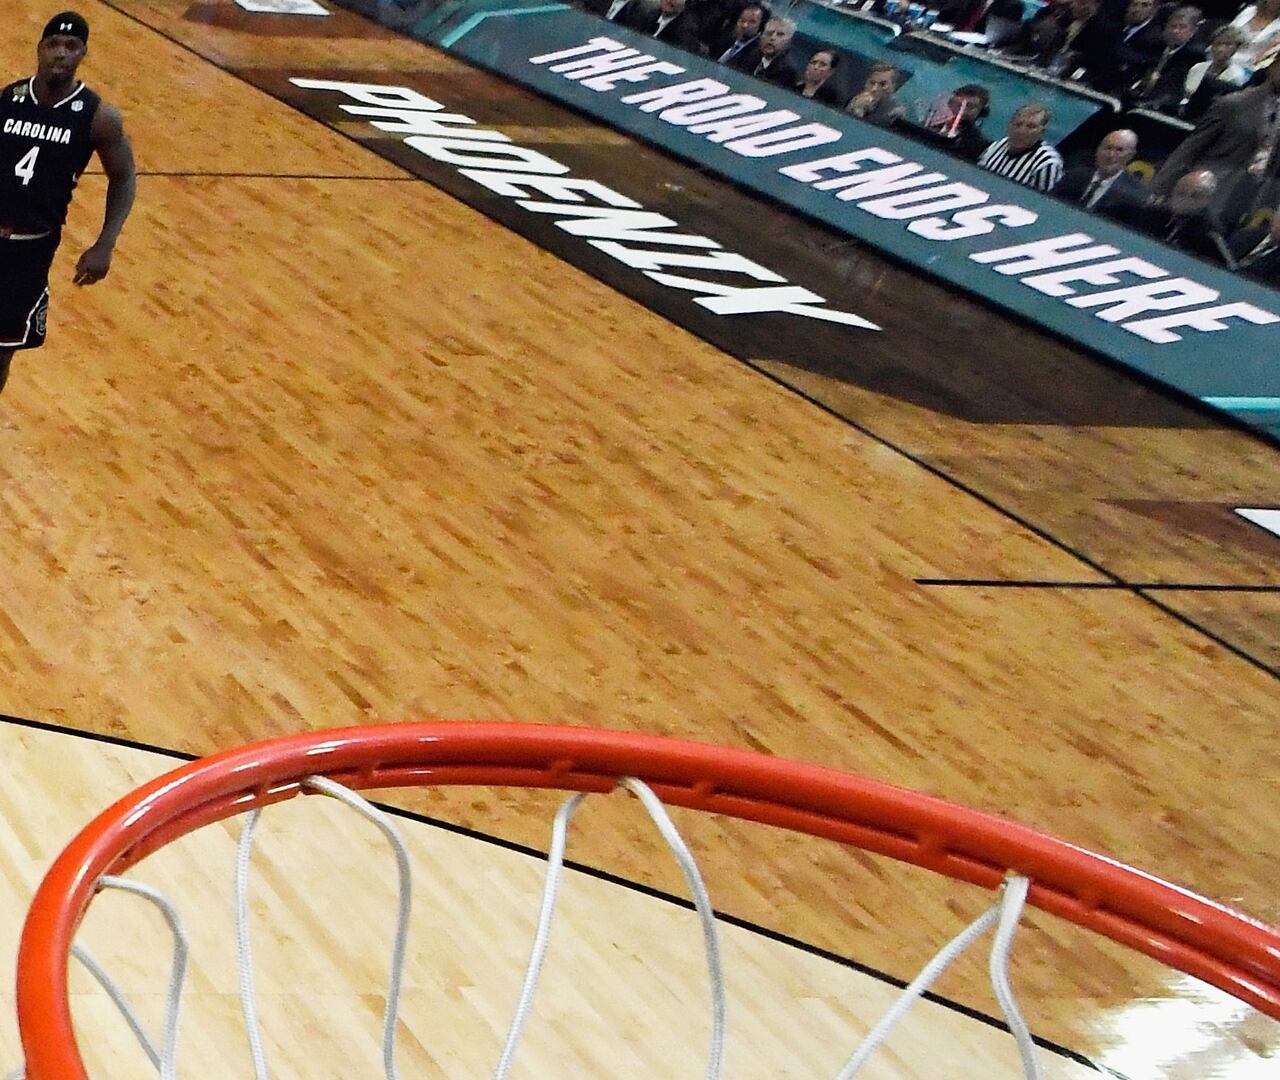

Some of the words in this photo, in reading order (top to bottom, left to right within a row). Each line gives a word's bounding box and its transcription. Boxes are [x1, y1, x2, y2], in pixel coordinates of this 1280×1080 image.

[3, 118, 72, 145] CAROLINA
[14, 145, 41, 186] 4
[289, 78, 883, 331] PHOENIX
[528, 36, 686, 92] THE
[620, 78, 843, 158] ROAD
[778, 147, 1040, 242] ENDS
[968, 232, 1280, 344] HERE
